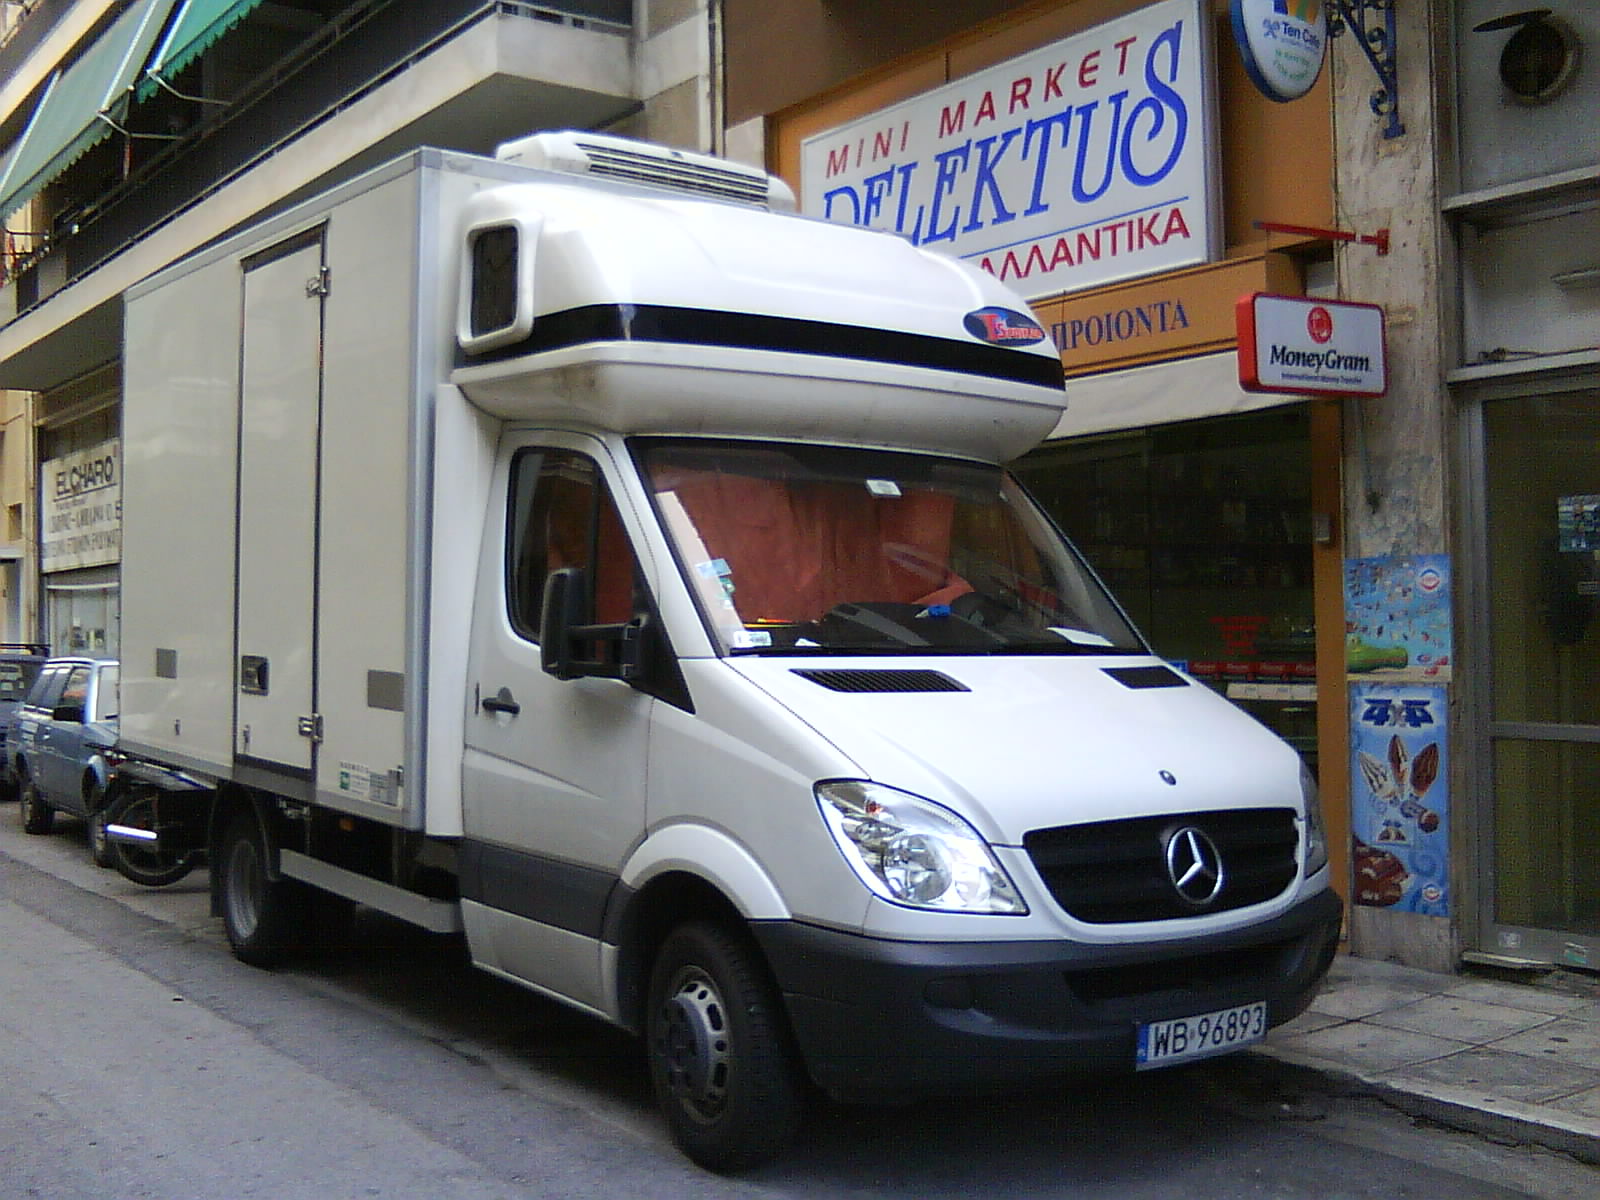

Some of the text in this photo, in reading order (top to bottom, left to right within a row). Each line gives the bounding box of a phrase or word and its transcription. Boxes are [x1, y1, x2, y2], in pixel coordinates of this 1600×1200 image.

[825, 36, 1138, 179] MINI MARKET
[1269, 344, 1370, 374] MoneyGram
[1154, 1005, 1264, 1058] WB 96893
